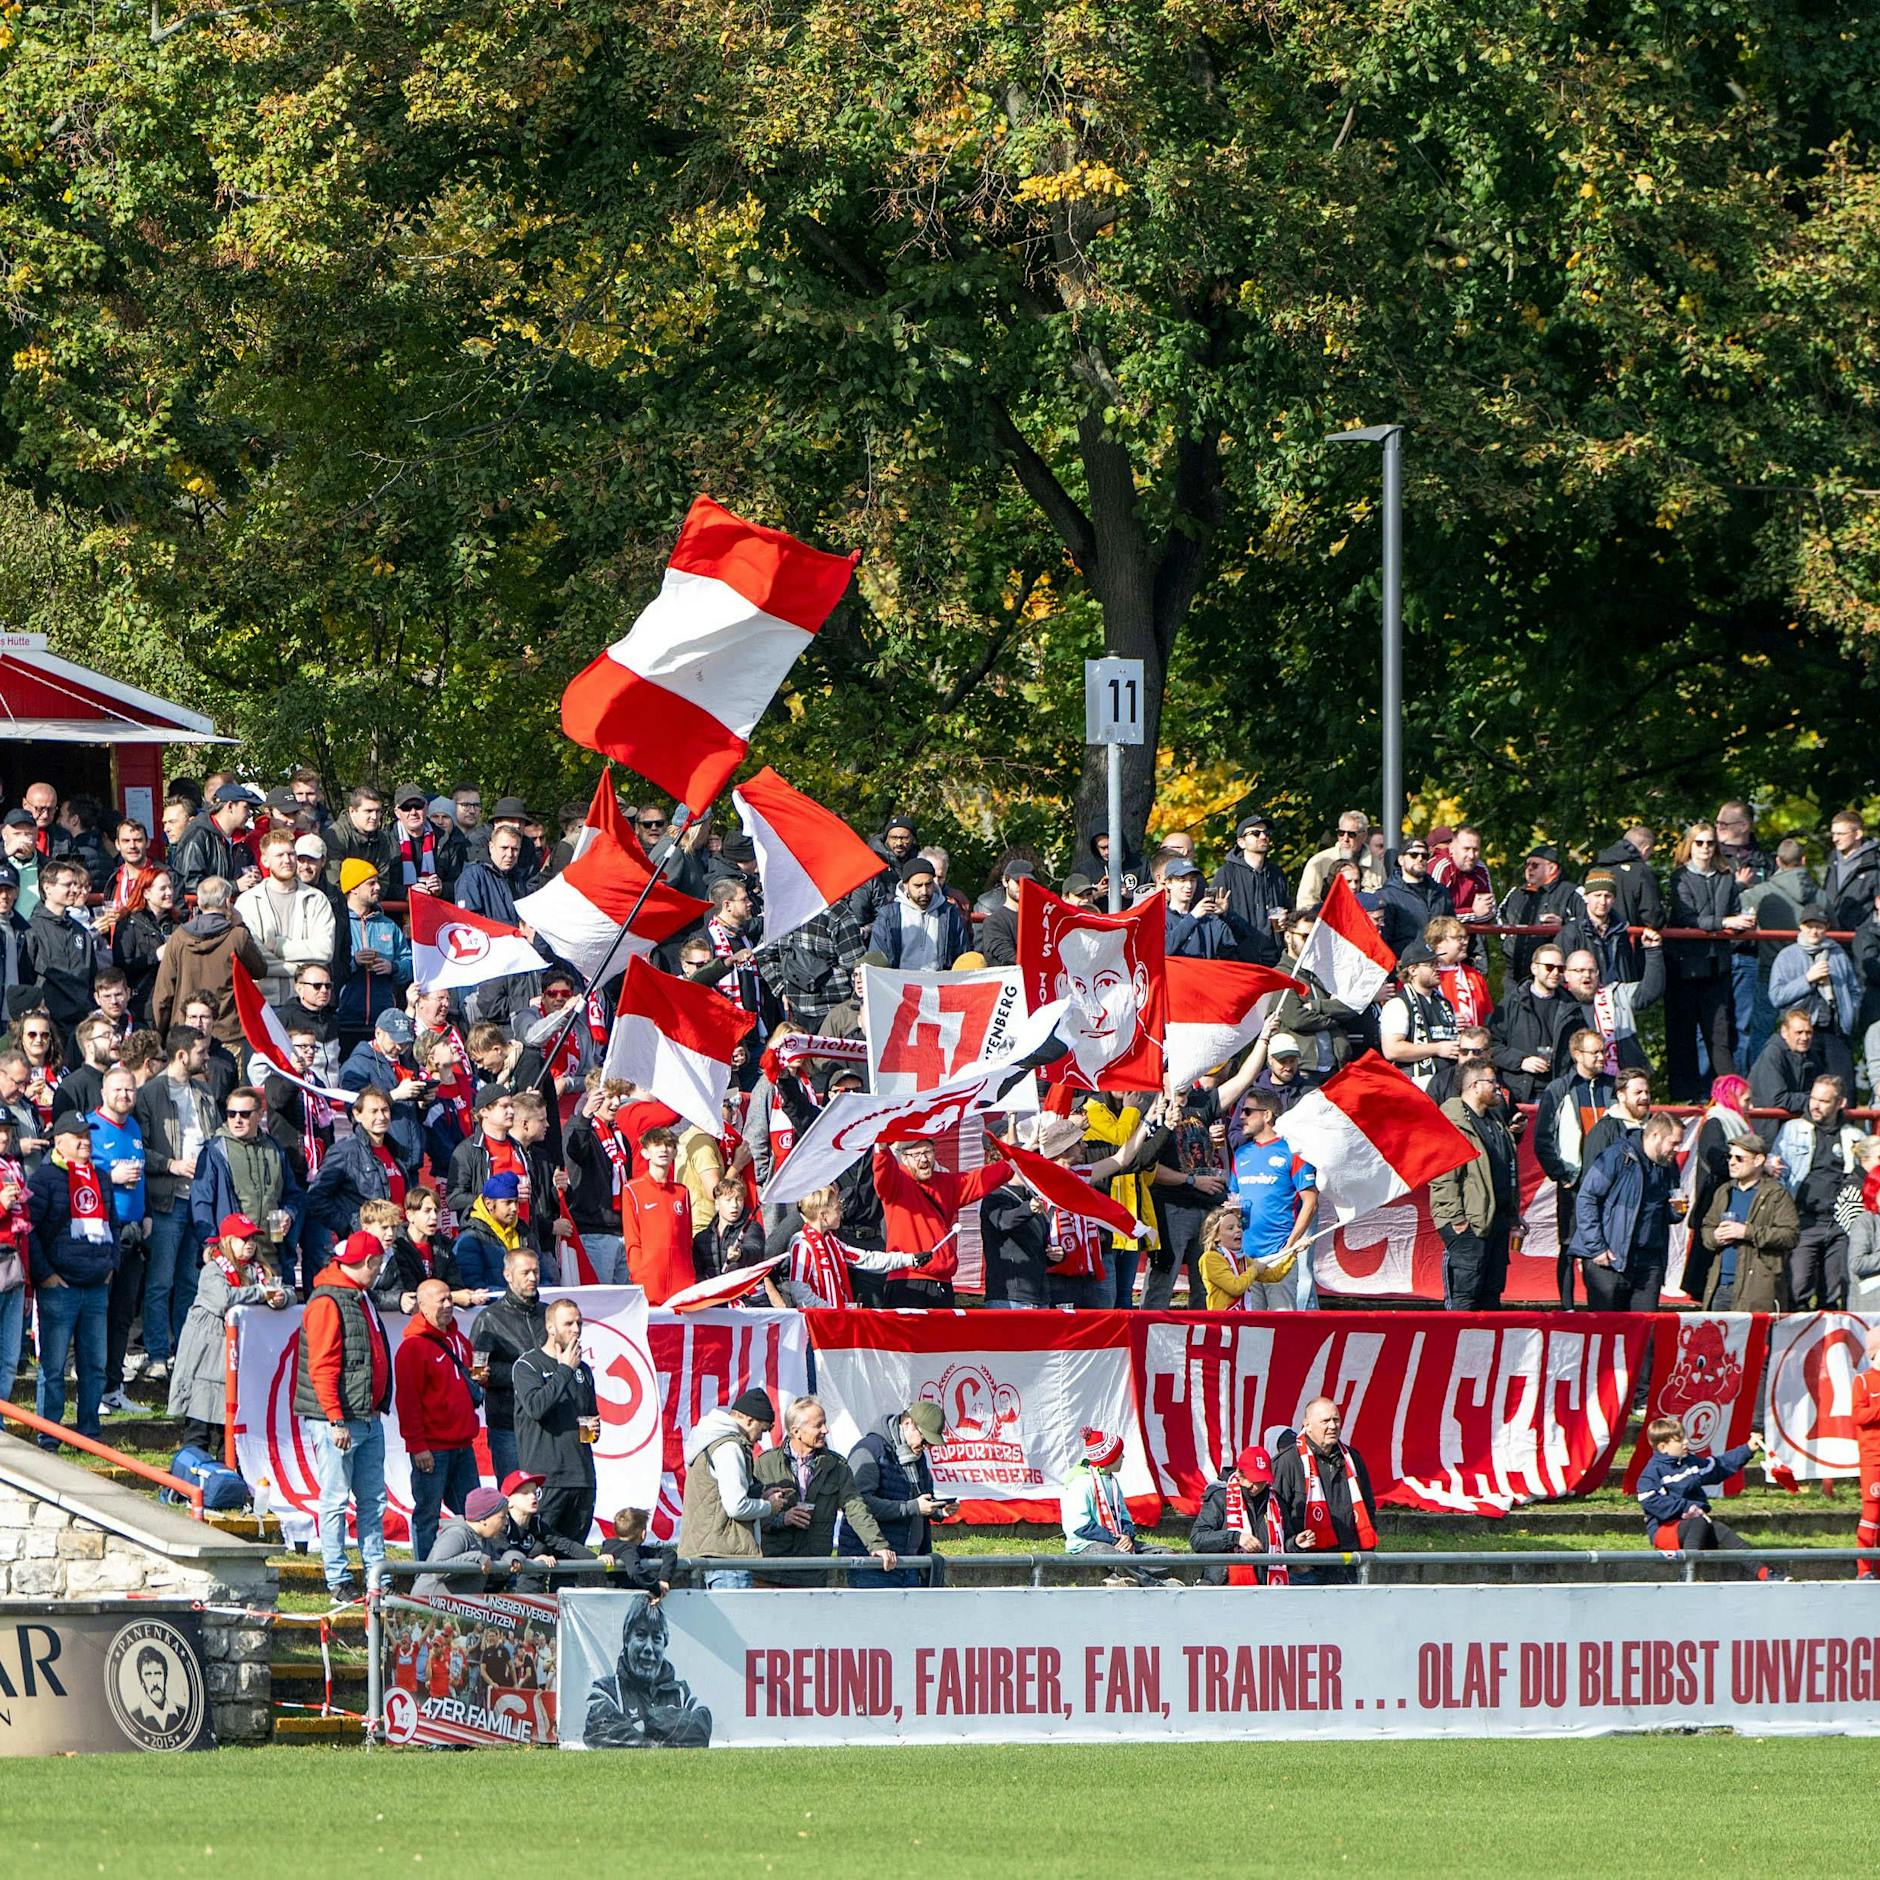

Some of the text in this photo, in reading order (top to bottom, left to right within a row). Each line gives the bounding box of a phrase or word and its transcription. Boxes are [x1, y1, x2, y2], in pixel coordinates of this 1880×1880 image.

[7, 636, 30, 646] Hütte
[1108, 679, 1136, 723] 11
[878, 981, 1003, 1093] 47
[985, 985, 1017, 1060] TENBERG
[806, 1035, 867, 1053] Lichte
[931, 1443, 1021, 1460] SUPPORTERS
[932, 1467, 1044, 1484] CHTENBERG
[428, 1595, 516, 1629] WIR UNTERSTÜTZEN
[483, 1594, 557, 1625] UNSEREN VEREIN
[118, 1626, 180, 1653] PANENKA
[745, 1648, 902, 1723] FREUND,
[916, 1646, 1072, 1720] FAHRER,
[1085, 1645, 1170, 1719] FAN,
[1418, 1643, 1508, 1708] OLAF
[1520, 1642, 1567, 1708] DU
[1579, 1640, 1719, 1706] BLEIBST
[420, 1697, 533, 1743] 47ER FAMILIE
[151, 1735, 175, 1749] 2015
